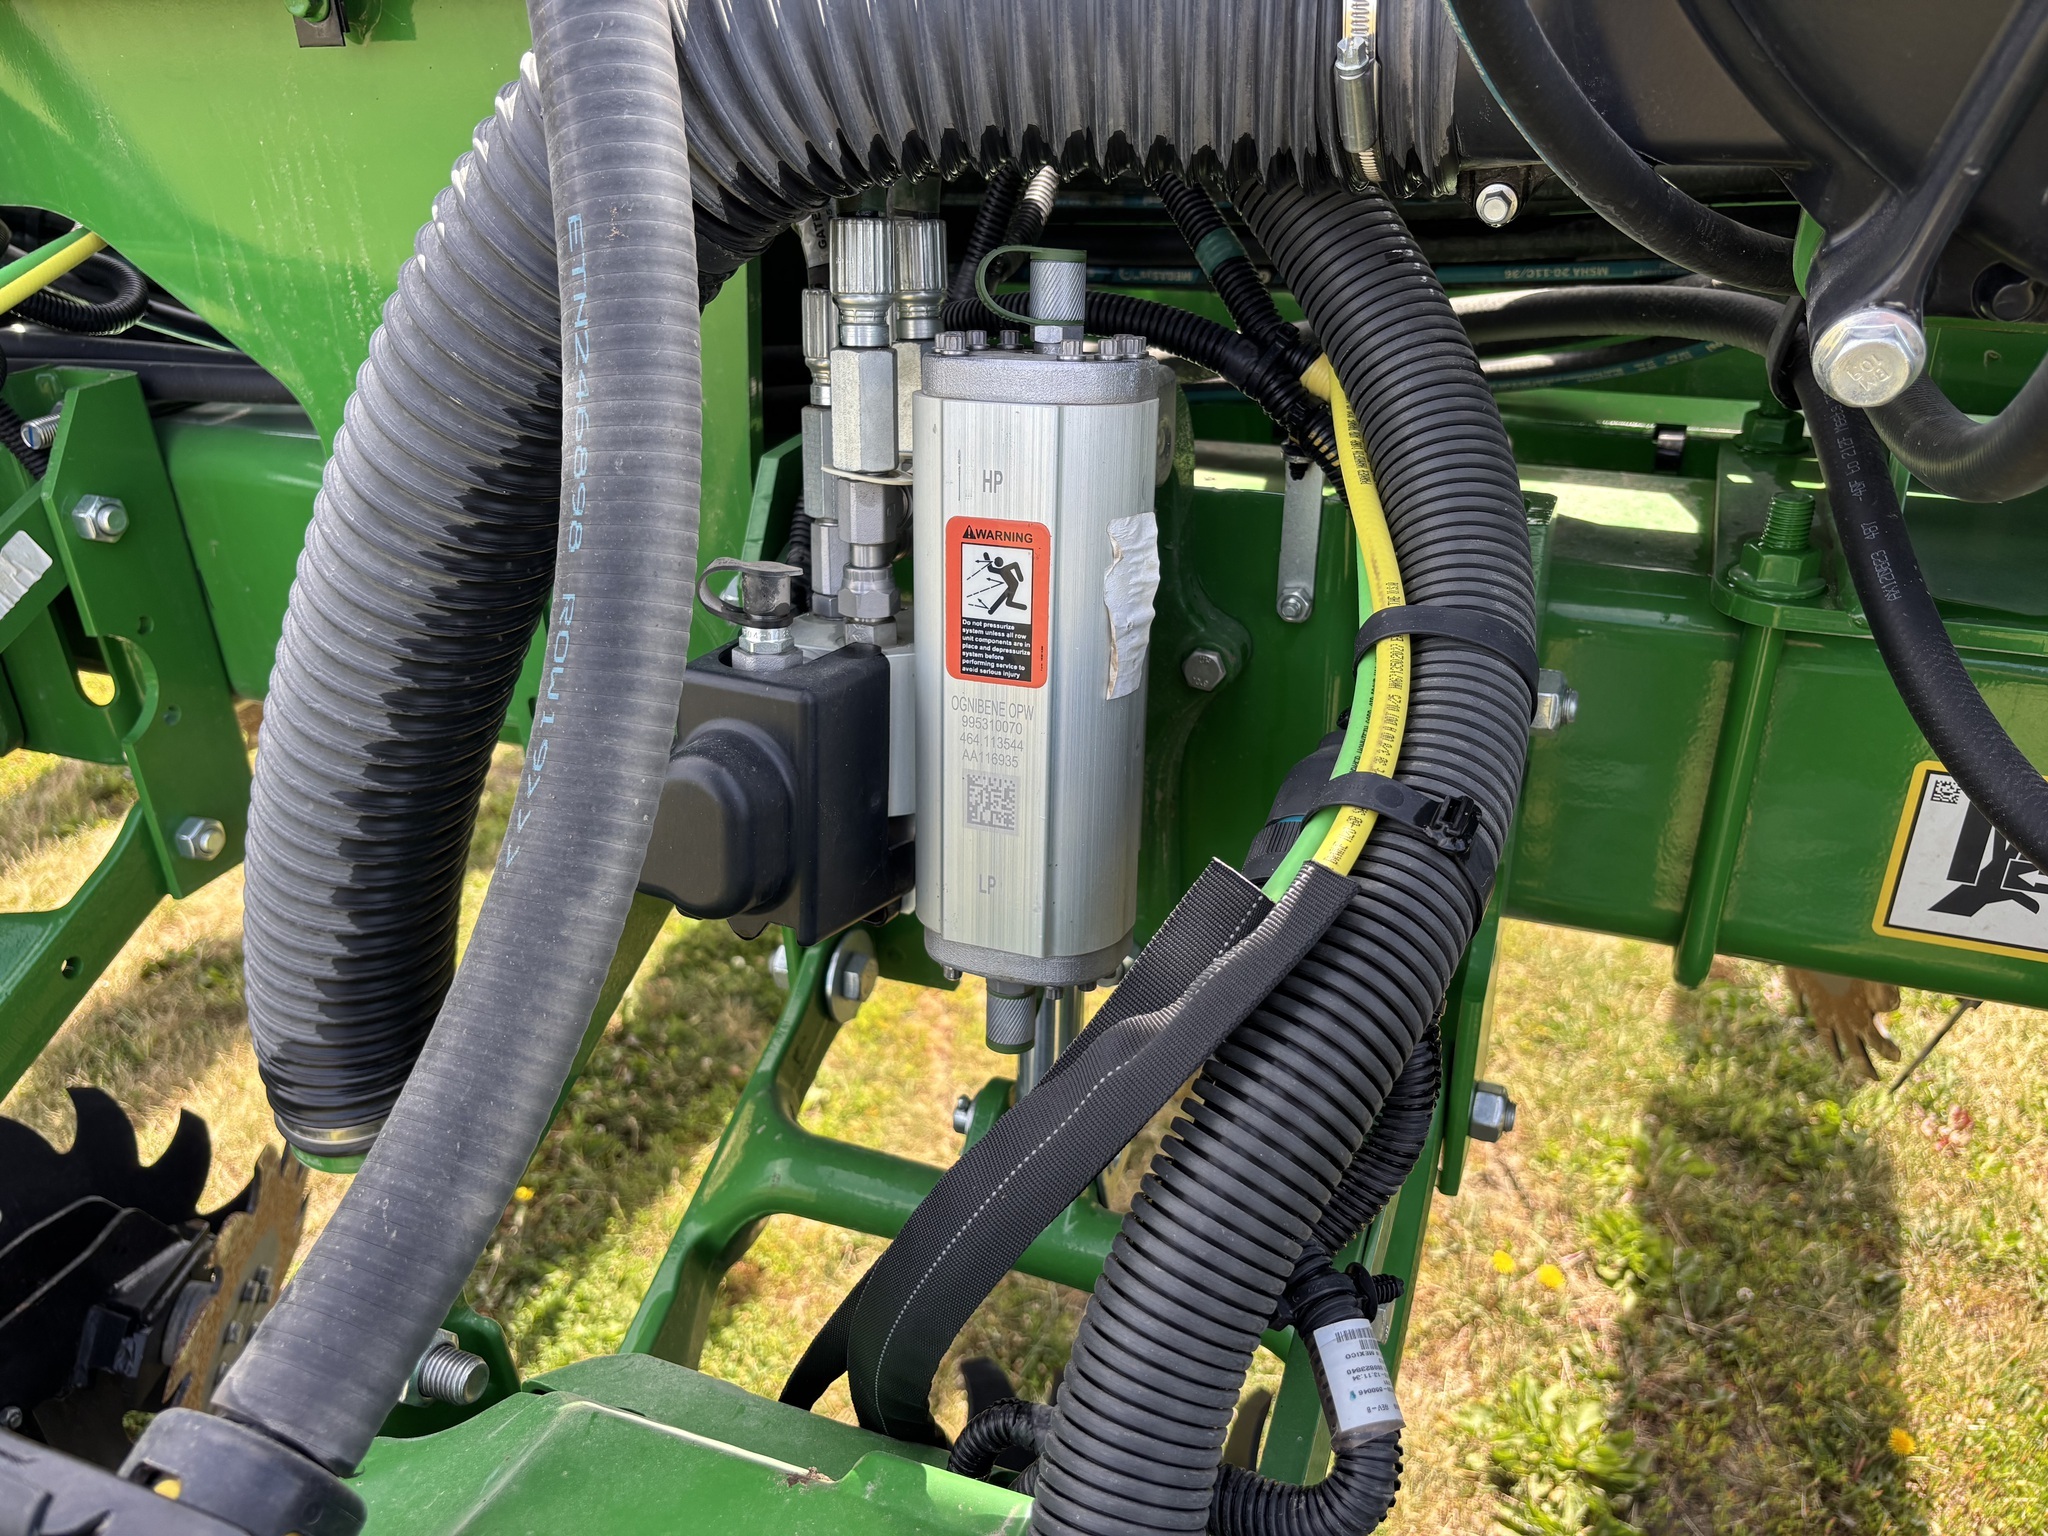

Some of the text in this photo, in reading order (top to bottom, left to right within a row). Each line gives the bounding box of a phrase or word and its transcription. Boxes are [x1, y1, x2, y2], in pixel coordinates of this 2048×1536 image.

[982, 469, 1003, 493] HP
[975, 528, 1033, 544] WARNING
[983, 622, 1015, 630] pressurize
[975, 637, 1012, 645] components
[985, 652, 1004, 660] before
[992, 646, 1031, 656] depressurize
[962, 659, 995, 669] performing
[996, 662, 1018, 671] service
[979, 668, 1002, 676] serious
[1002, 670, 1021, 679] injury
[951, 695, 1035, 721] OGNIBENE OPW
[961, 715, 1023, 735] 995310070
[960, 732, 1024, 752] 464.113544
[962, 749, 1019, 768] AA116935
[978, 874, 996, 895] LP
[1345, 1351, 1375, 1360] MEXICO
